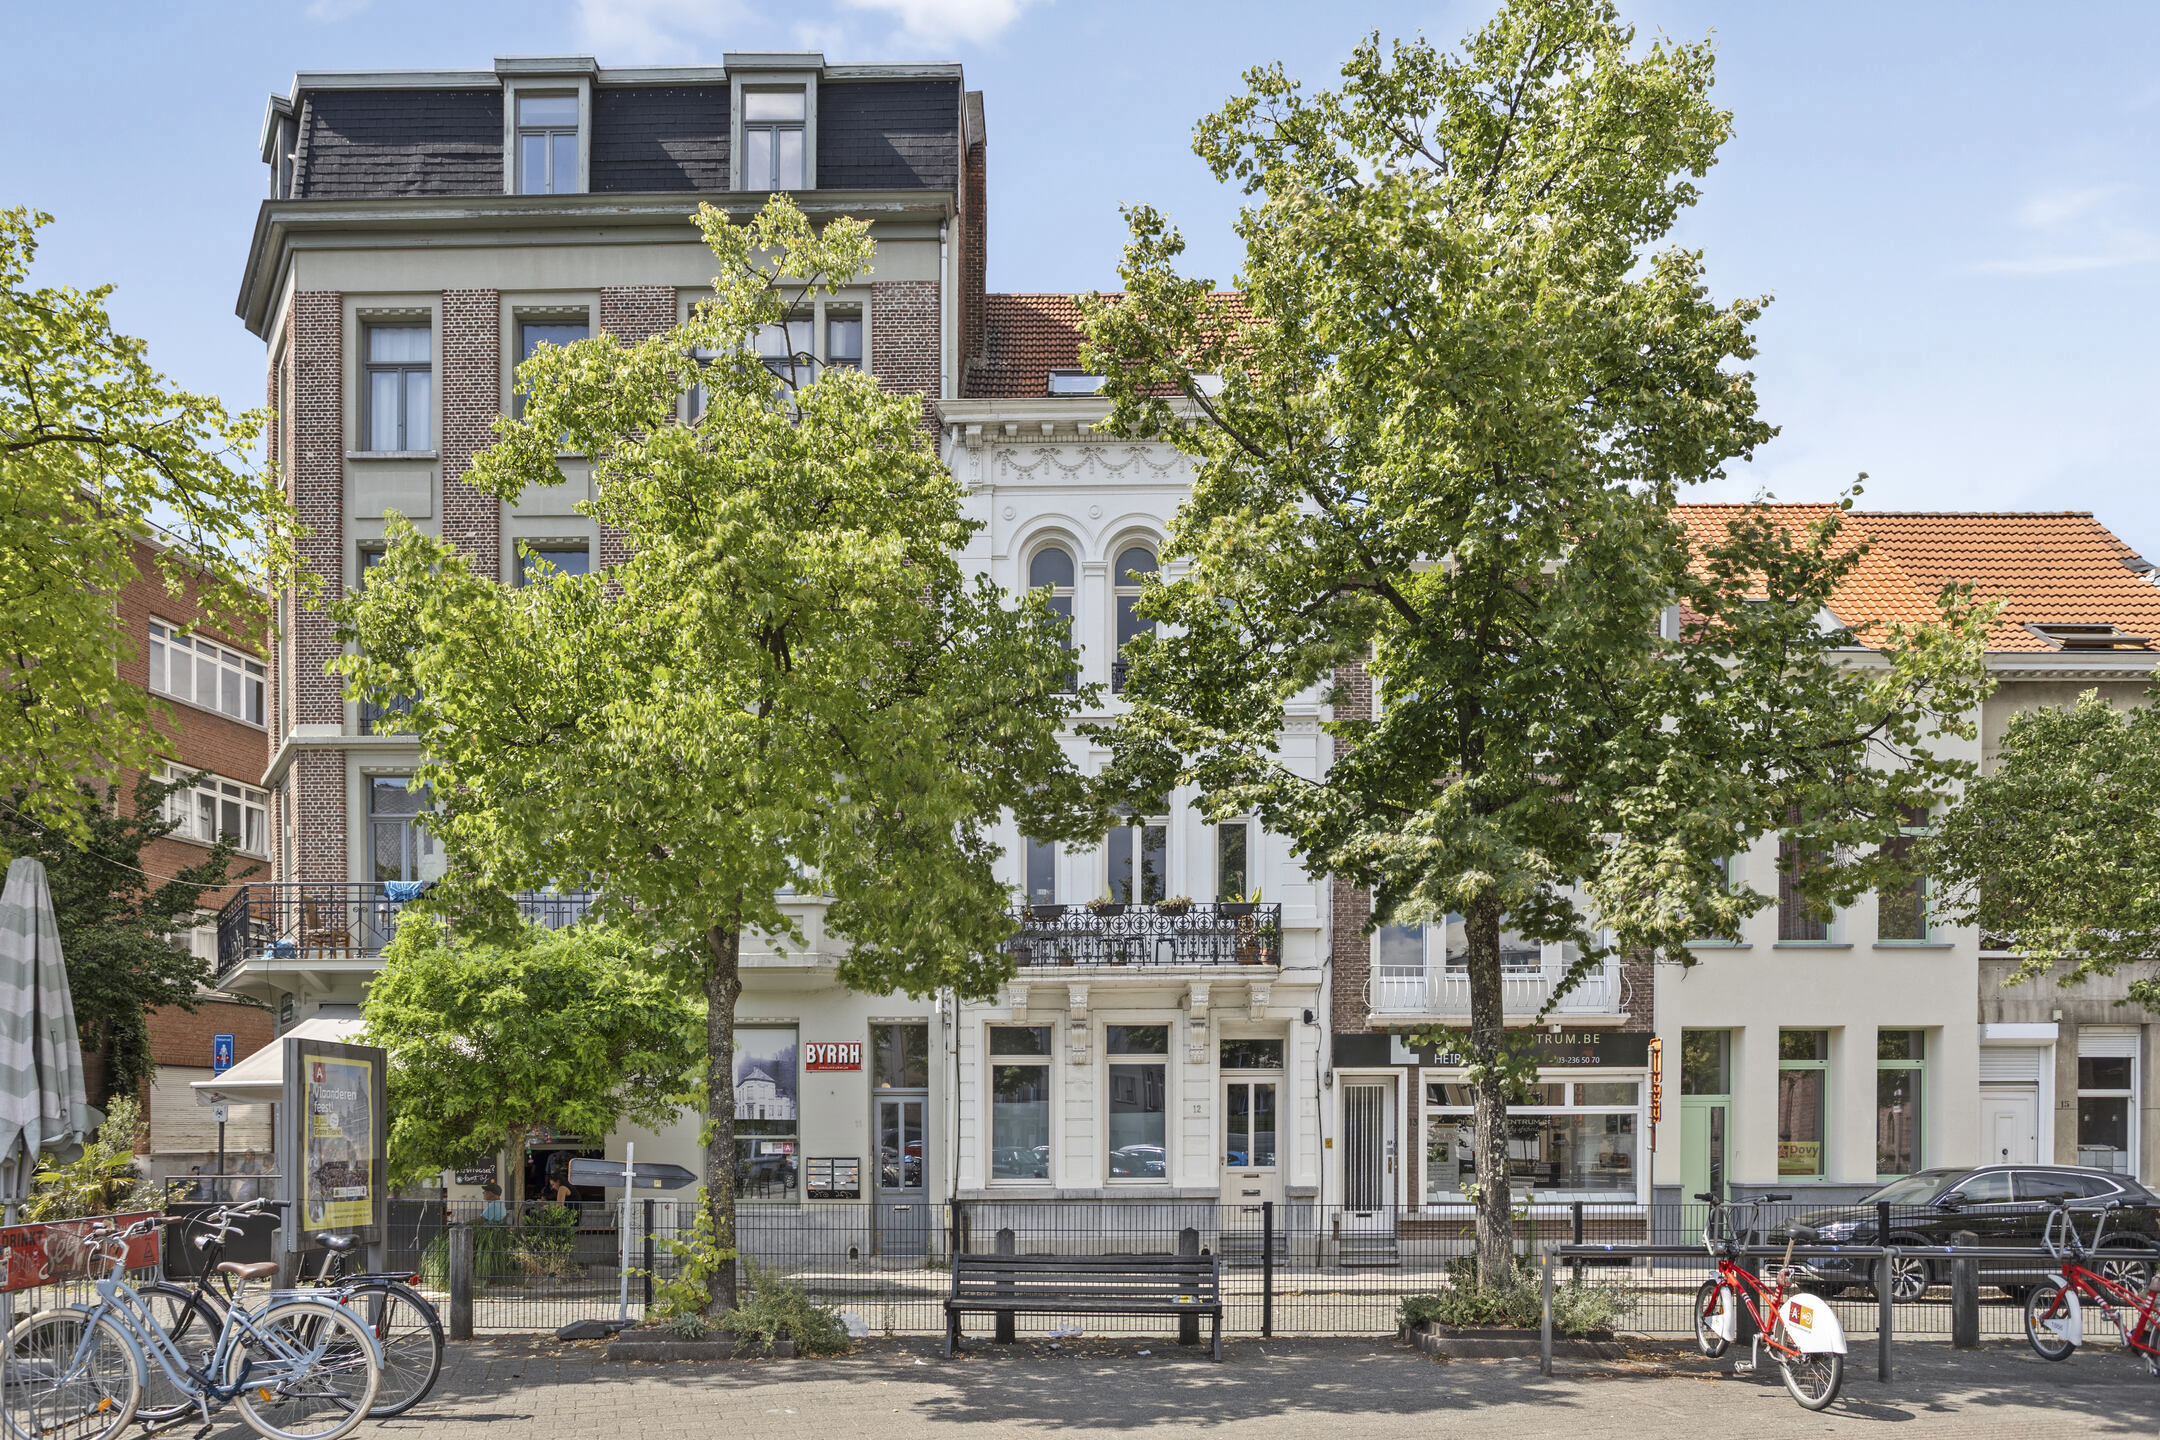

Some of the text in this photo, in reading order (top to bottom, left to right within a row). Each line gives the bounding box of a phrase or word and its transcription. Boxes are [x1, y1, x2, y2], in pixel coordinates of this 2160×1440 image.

[806, 1044, 860, 1064] BYRRH
[1581, 1056, 1590, 1064] 50
[1592, 1056, 1600, 1064] 70
[316, 1067, 323, 1079] A
[313, 1086, 357, 1101] Vlaanderen
[314, 1101, 334, 1113] feest!
[1193, 1104, 1201, 1113] 12
[2061, 1100, 2070, 1109] 15
[1790, 1145, 1818, 1158] Dovy
[2, 1230, 43, 1248] DRINKT
